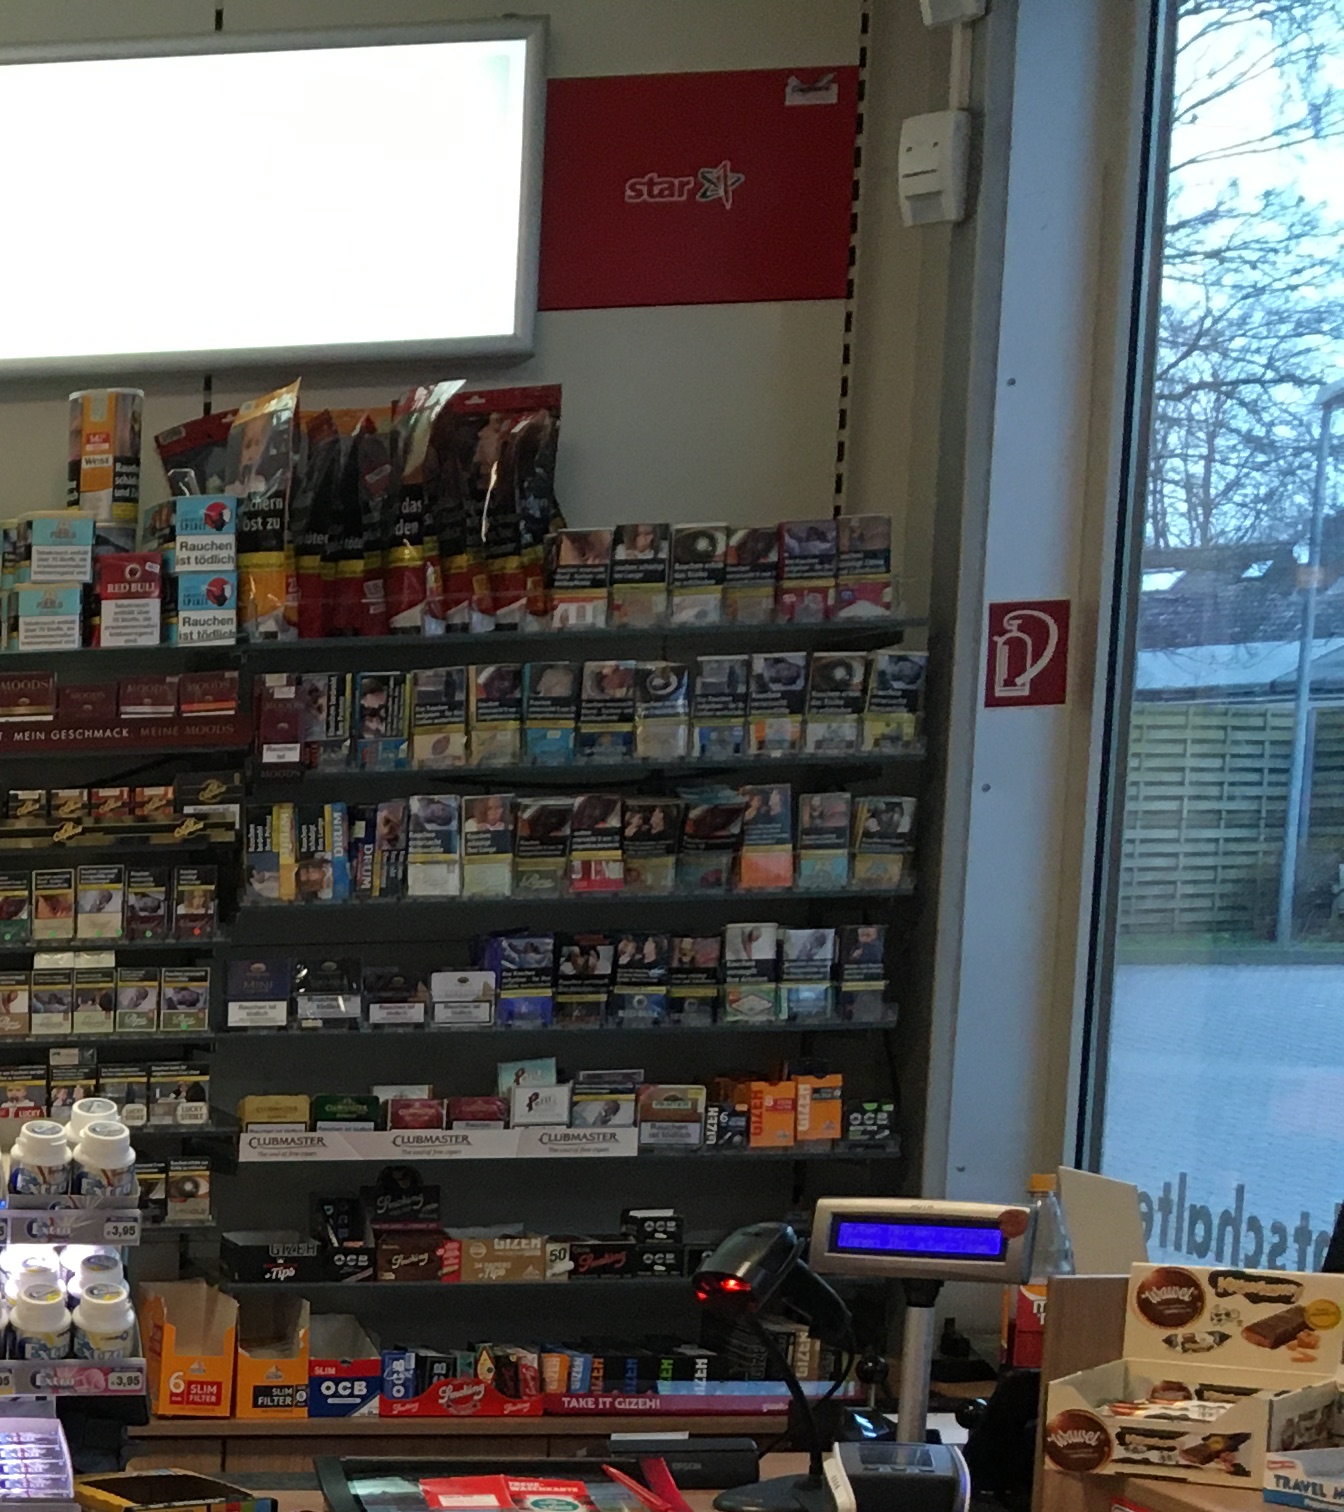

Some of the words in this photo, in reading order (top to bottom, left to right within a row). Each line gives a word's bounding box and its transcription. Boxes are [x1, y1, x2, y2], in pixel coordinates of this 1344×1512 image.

[625, 174, 695, 201] star
[106, 581, 129, 594] RED
[131, 581, 160, 594] BULL
[13, 730, 47, 743] MEIN
[140, 725, 180, 738] MEINE
[184, 722, 235, 737] MOODS
[332, 811, 344, 858] DRUM
[363, 843, 374, 889] DRUM
[798, 1084, 810, 1131] GIZEH
[849, 1112, 888, 1125] OCB
[248, 1135, 327, 1149] CLUBMASTER
[392, 1133, 473, 1148] CLUBMASTER
[538, 1131, 619, 1147] CLUBMASTER
[313, 1366, 336, 1376] SLIM
[169, 1371, 185, 1395] 6
[189, 1383, 217, 1395] SLIM
[320, 1380, 368, 1396] OCB
[189, 1394, 217, 1404] FILTER
[272, 1387, 293, 1396] SLIM
[257, 1396, 292, 1406] FILTER
[562, 1397, 596, 1409] TAKE
[598, 1397, 612, 1409] IT
[614, 1397, 661, 1410] GIZEH!
[1274, 1474, 1327, 1498] TRAVEL
